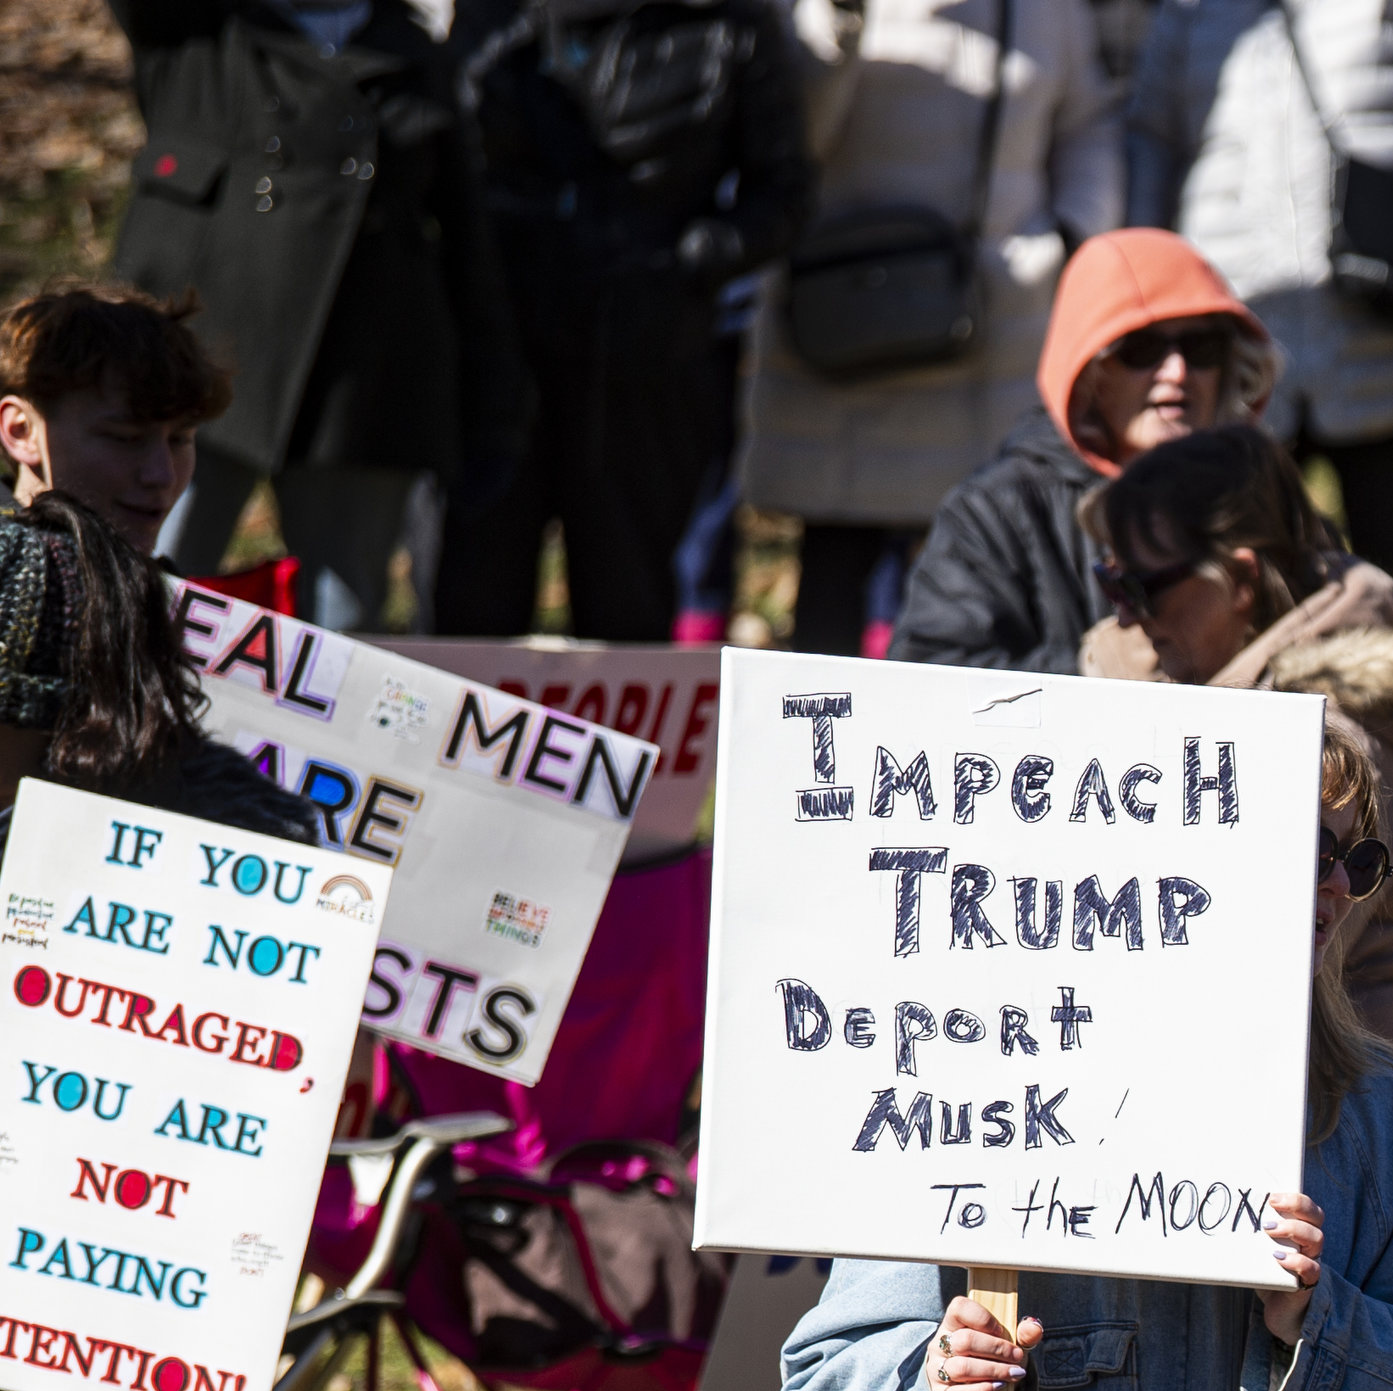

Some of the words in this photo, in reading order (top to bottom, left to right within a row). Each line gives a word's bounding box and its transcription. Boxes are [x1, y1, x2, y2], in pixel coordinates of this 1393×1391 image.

[170, 583, 336, 722] EAL
[439, 686, 661, 822] MEN
[782, 692, 1240, 828] IMPEACH
[105, 820, 163, 868] IF
[199, 843, 313, 904] YOU
[868, 846, 1212, 958] TRUMP
[63, 896, 173, 954] ARE
[202, 925, 320, 984] NOT
[13, 965, 315, 1093] OUTRAGED,
[21, 1061, 133, 1121] YOU
[154, 1098, 268, 1158] ARE
[70, 1157, 190, 1220] NOT
[930, 1183, 987, 1234] To
[1115, 1172, 1271, 1237] MOON
[9, 1227, 208, 1309] PAYING
